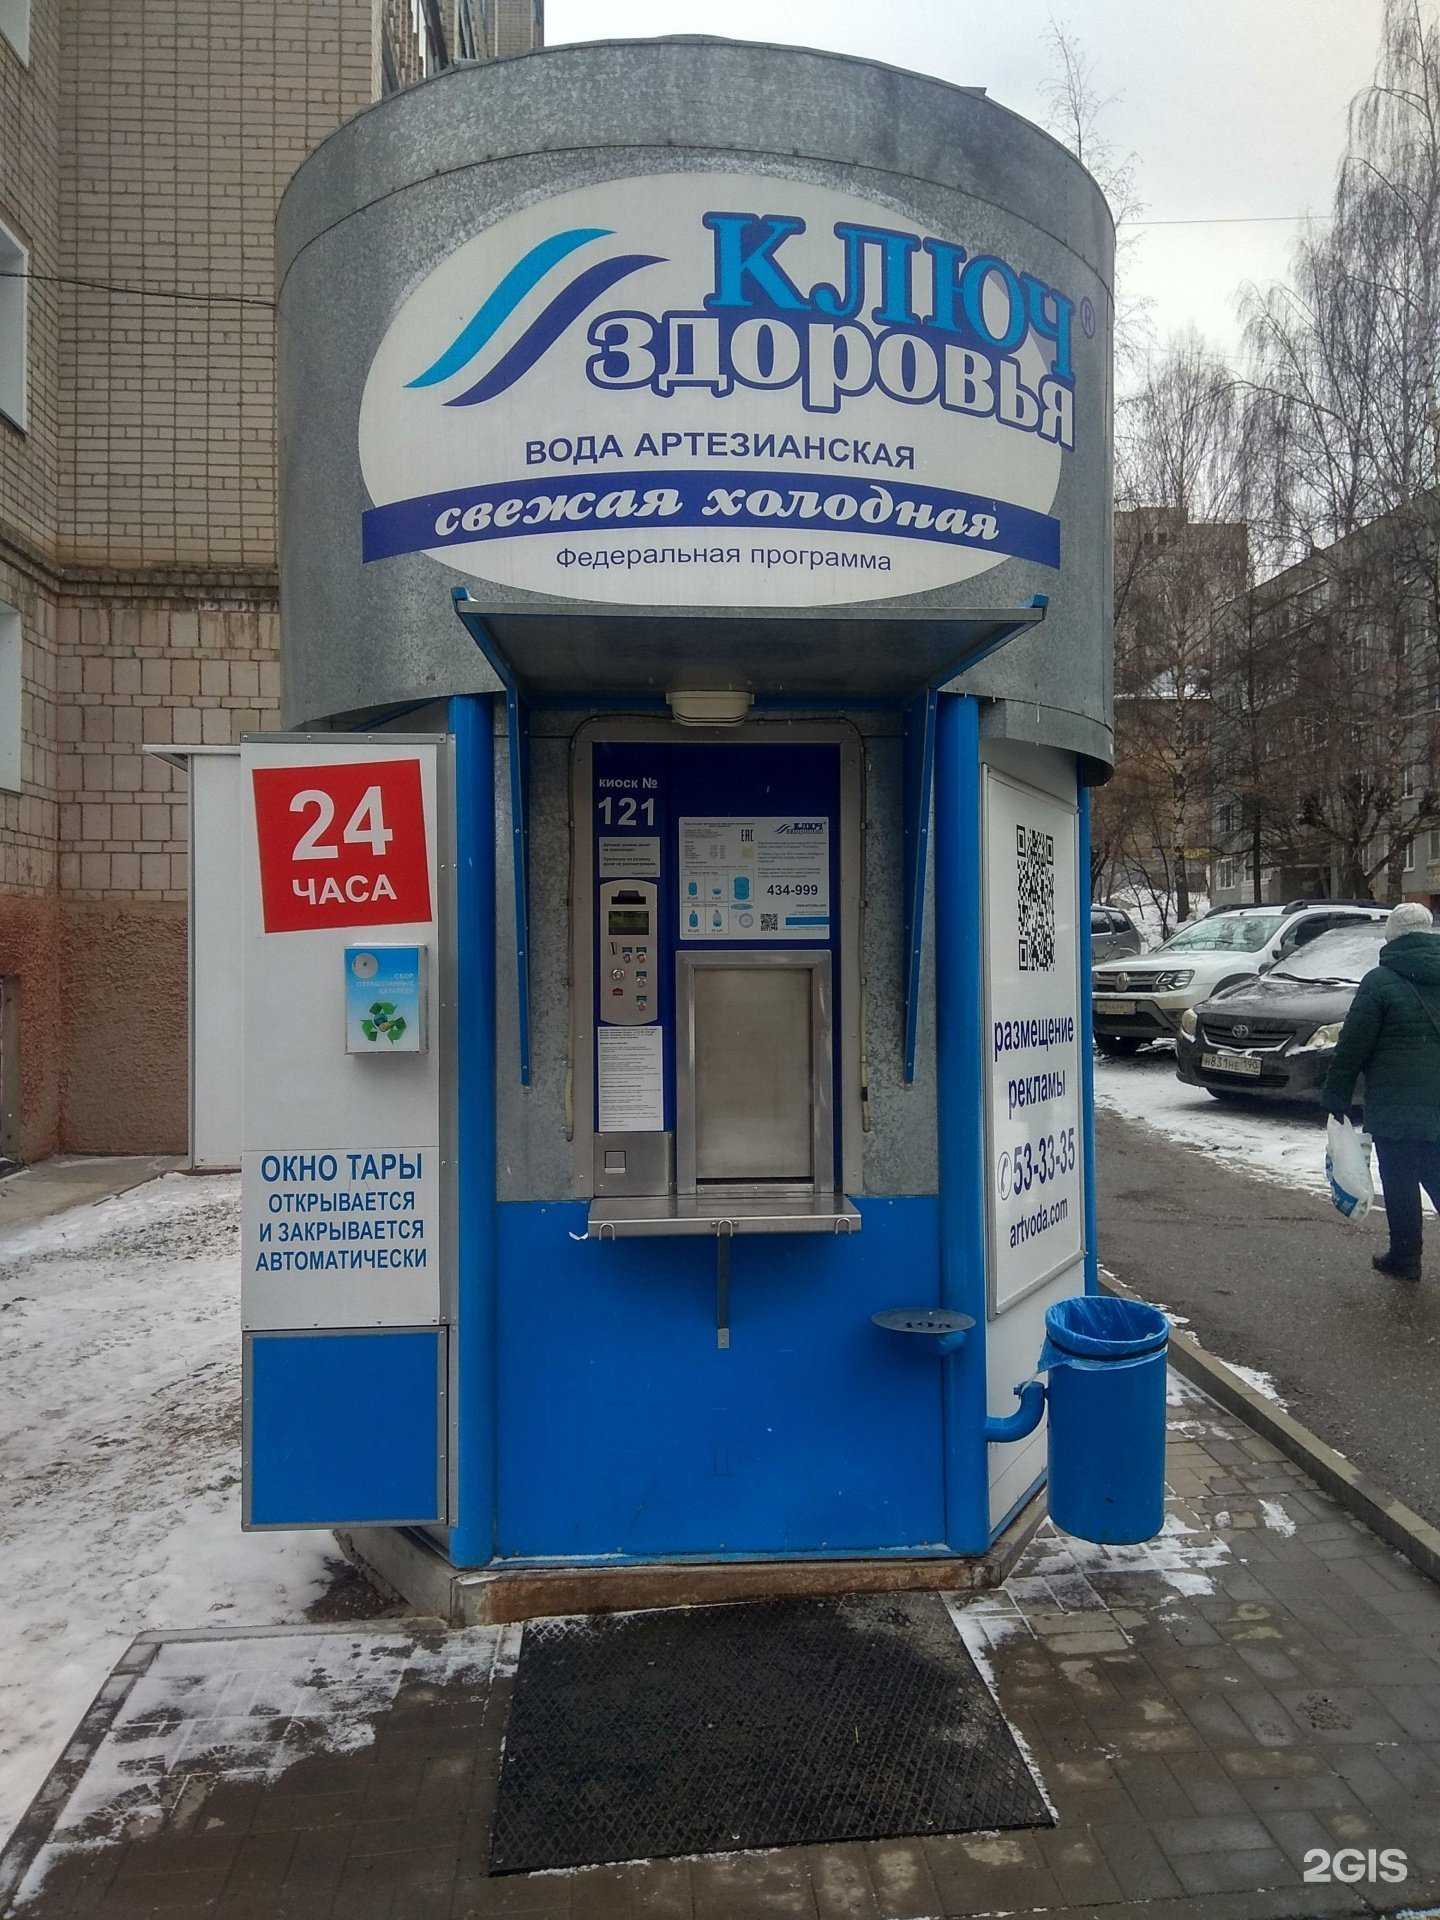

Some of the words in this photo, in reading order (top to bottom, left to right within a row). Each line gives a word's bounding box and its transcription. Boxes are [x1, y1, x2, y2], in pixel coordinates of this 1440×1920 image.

[702, 211, 1077, 382] КЛЮЧ
[525, 434, 624, 466] ВОДА
[634, 431, 917, 471] АРТЕЗИАНСКАЯ
[434, 487, 682, 537] свежая
[702, 485, 1001, 541] холодная
[556, 543, 742, 570] Федеральная
[750, 548, 893, 574] программа
[642, 777, 659, 789] №
[288, 785, 394, 861] 24
[598, 796, 655, 826] 121
[292, 873, 398, 905] ЧАСА
[766, 884, 819, 896] 434-999
[994, 1016, 1074, 1062] размещение
[1008, 1069, 1066, 1120] рекламы
[261, 1154, 338, 1182] ОКНО
[346, 1152, 422, 1180] ТАРЫ
[1013, 1127, 1075, 1196] 53-33-35
[268, 1191, 416, 1213] ОТКРЫВАЕТСЯ
[259, 1222, 272, 1242] И
[278, 1219, 425, 1242] ЗАКРЫВАЕТСЯ
[1009, 1198, 1068, 1249] artvoda.com
[255, 1248, 427, 1272] АВТОМАТИЧЕСКИ
